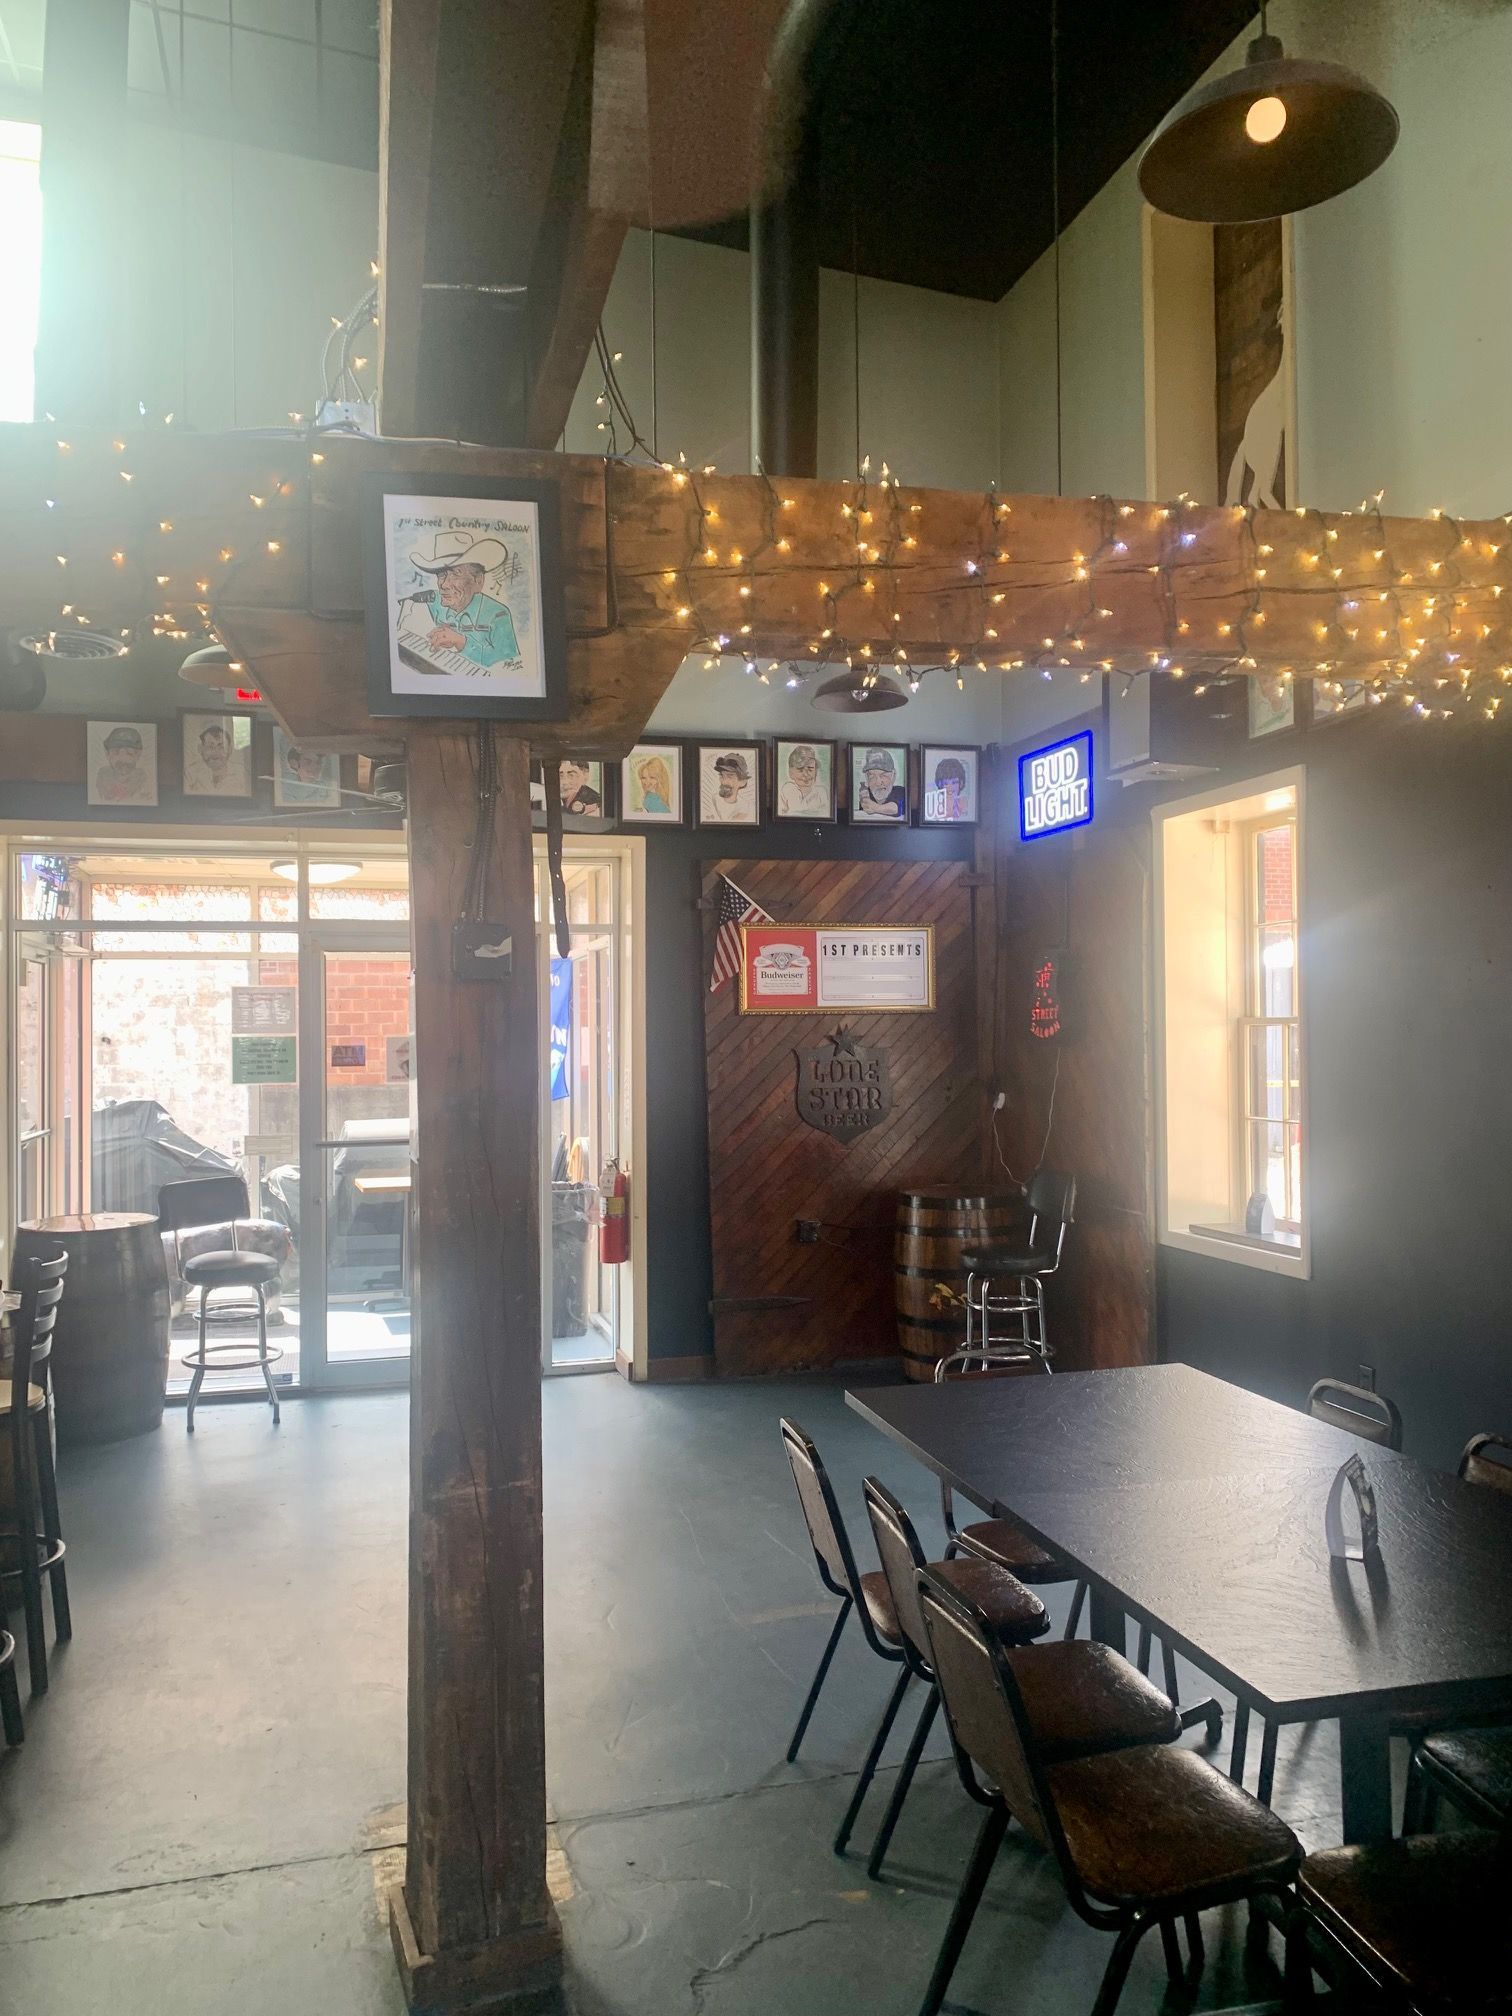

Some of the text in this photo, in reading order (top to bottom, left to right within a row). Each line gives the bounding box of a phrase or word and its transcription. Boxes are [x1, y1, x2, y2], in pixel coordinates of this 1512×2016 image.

[414, 517, 442, 528] Street
[449, 517, 491, 532] Country
[494, 520, 530, 533] SALOON
[1031, 747, 1079, 794] BUD
[823, 944, 921, 956] 1ST PRESENTS
[760, 971, 804, 979] Budweiser
[1031, 1006, 1059, 1020] STREET
[1030, 1021, 1060, 1038] SALOON
[813, 1060, 880, 1083] LONE
[810, 1087, 882, 1110] STAR
